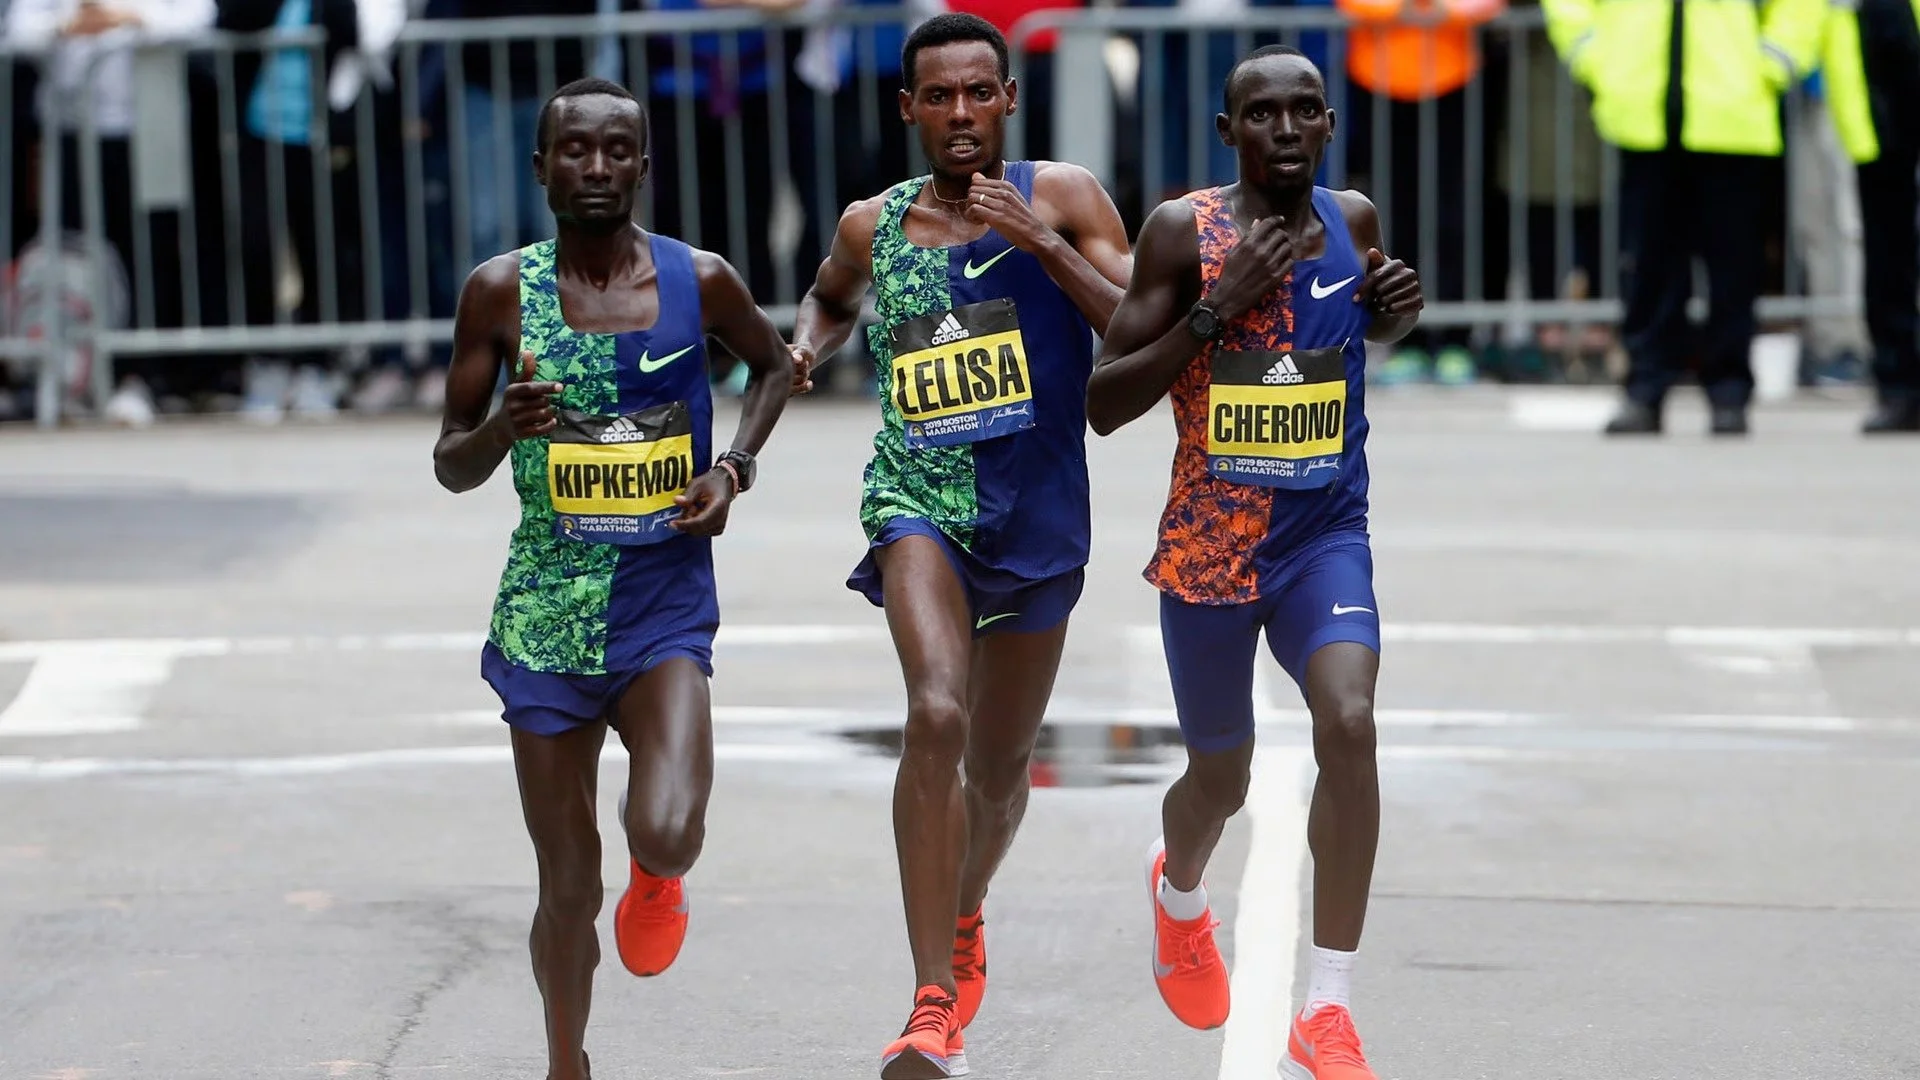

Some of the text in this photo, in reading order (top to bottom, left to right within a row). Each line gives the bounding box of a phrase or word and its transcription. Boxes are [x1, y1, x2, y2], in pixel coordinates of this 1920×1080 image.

[931, 329, 969, 345] adidas
[897, 344, 1026, 414] LELISA
[1262, 373, 1304, 384] adidas
[923, 414, 977, 430] 2019 BOSTON
[924, 421, 979, 436] MARATHON
[1215, 399, 1340, 443] CHERONO
[600, 431, 644, 443] adidas
[1236, 458, 1294, 468] 2019 BOSTON
[555, 455, 687, 498] KIPKEMOI
[1236, 467, 1295, 477] MARATHON
[580, 525, 640, 533] MARATHON
